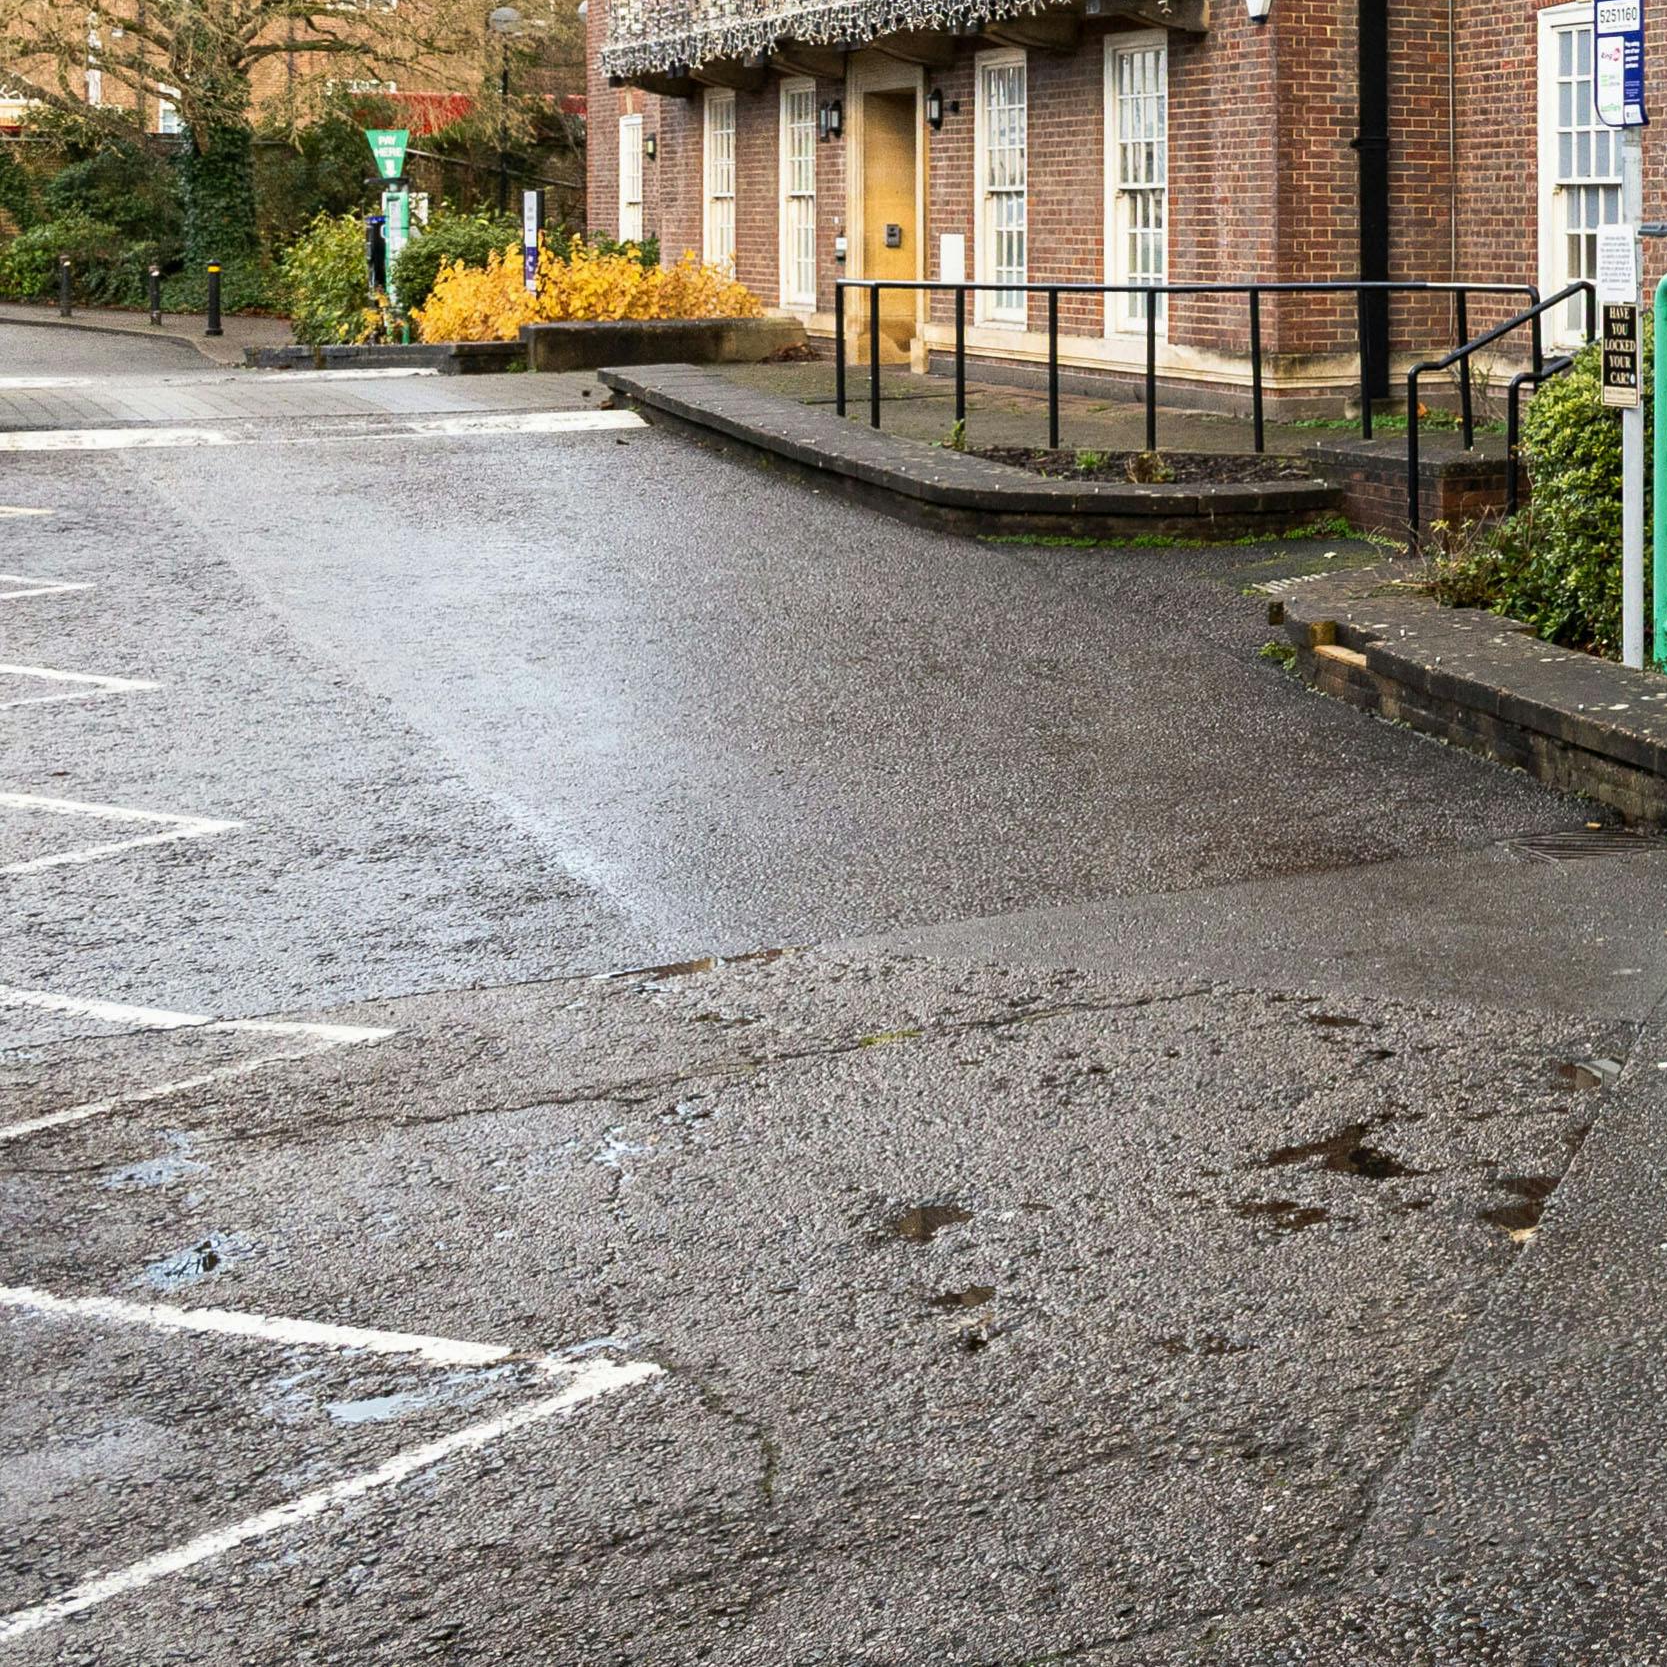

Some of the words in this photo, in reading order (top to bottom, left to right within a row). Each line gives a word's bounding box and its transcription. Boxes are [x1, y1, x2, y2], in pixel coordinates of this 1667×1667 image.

[1600, 7, 1637, 23] 5251160
[378, 135, 396, 145] PAY
[374, 147, 403, 157] HERE
[1609, 307, 1630, 319] HAVE
[1612, 323, 1628, 335] YOU
[1605, 339, 1636, 351] LOCKED
[1609, 355, 1631, 368] YOUR
